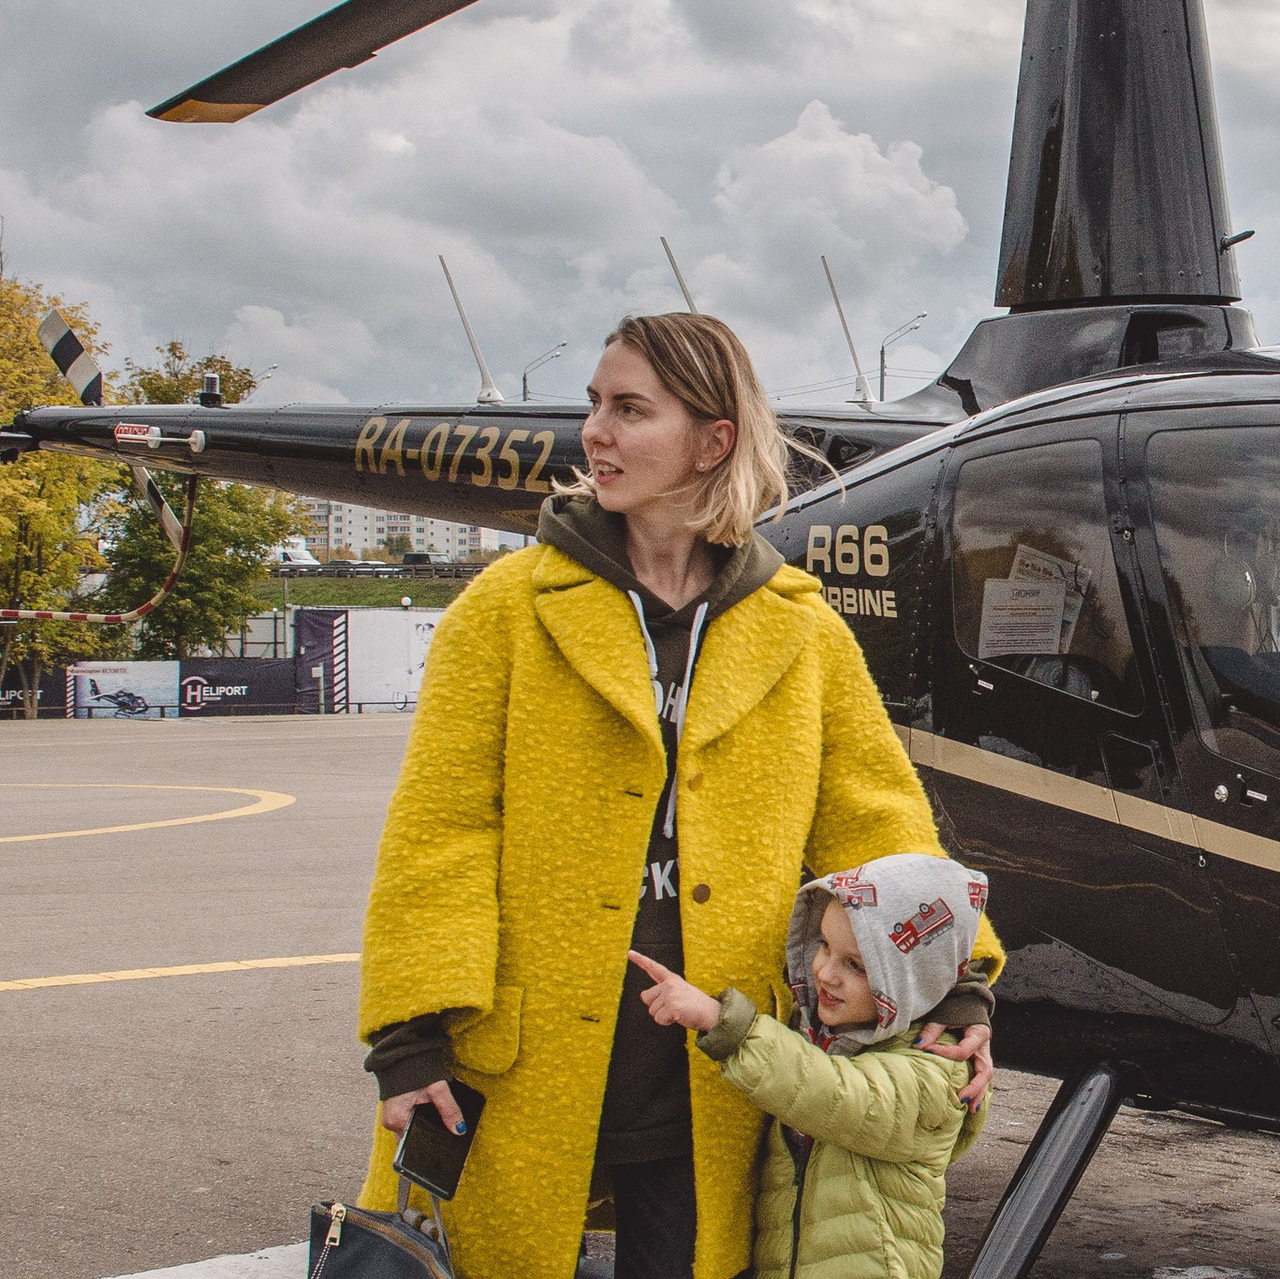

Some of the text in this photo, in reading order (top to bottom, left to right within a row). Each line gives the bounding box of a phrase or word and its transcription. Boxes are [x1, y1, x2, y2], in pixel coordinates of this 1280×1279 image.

[355, 416, 555, 493] RA-07352
[806, 524, 890, 577] R66
[821, 586, 898, 618] RBINE
[184, 683, 248, 703] HELIPORT
